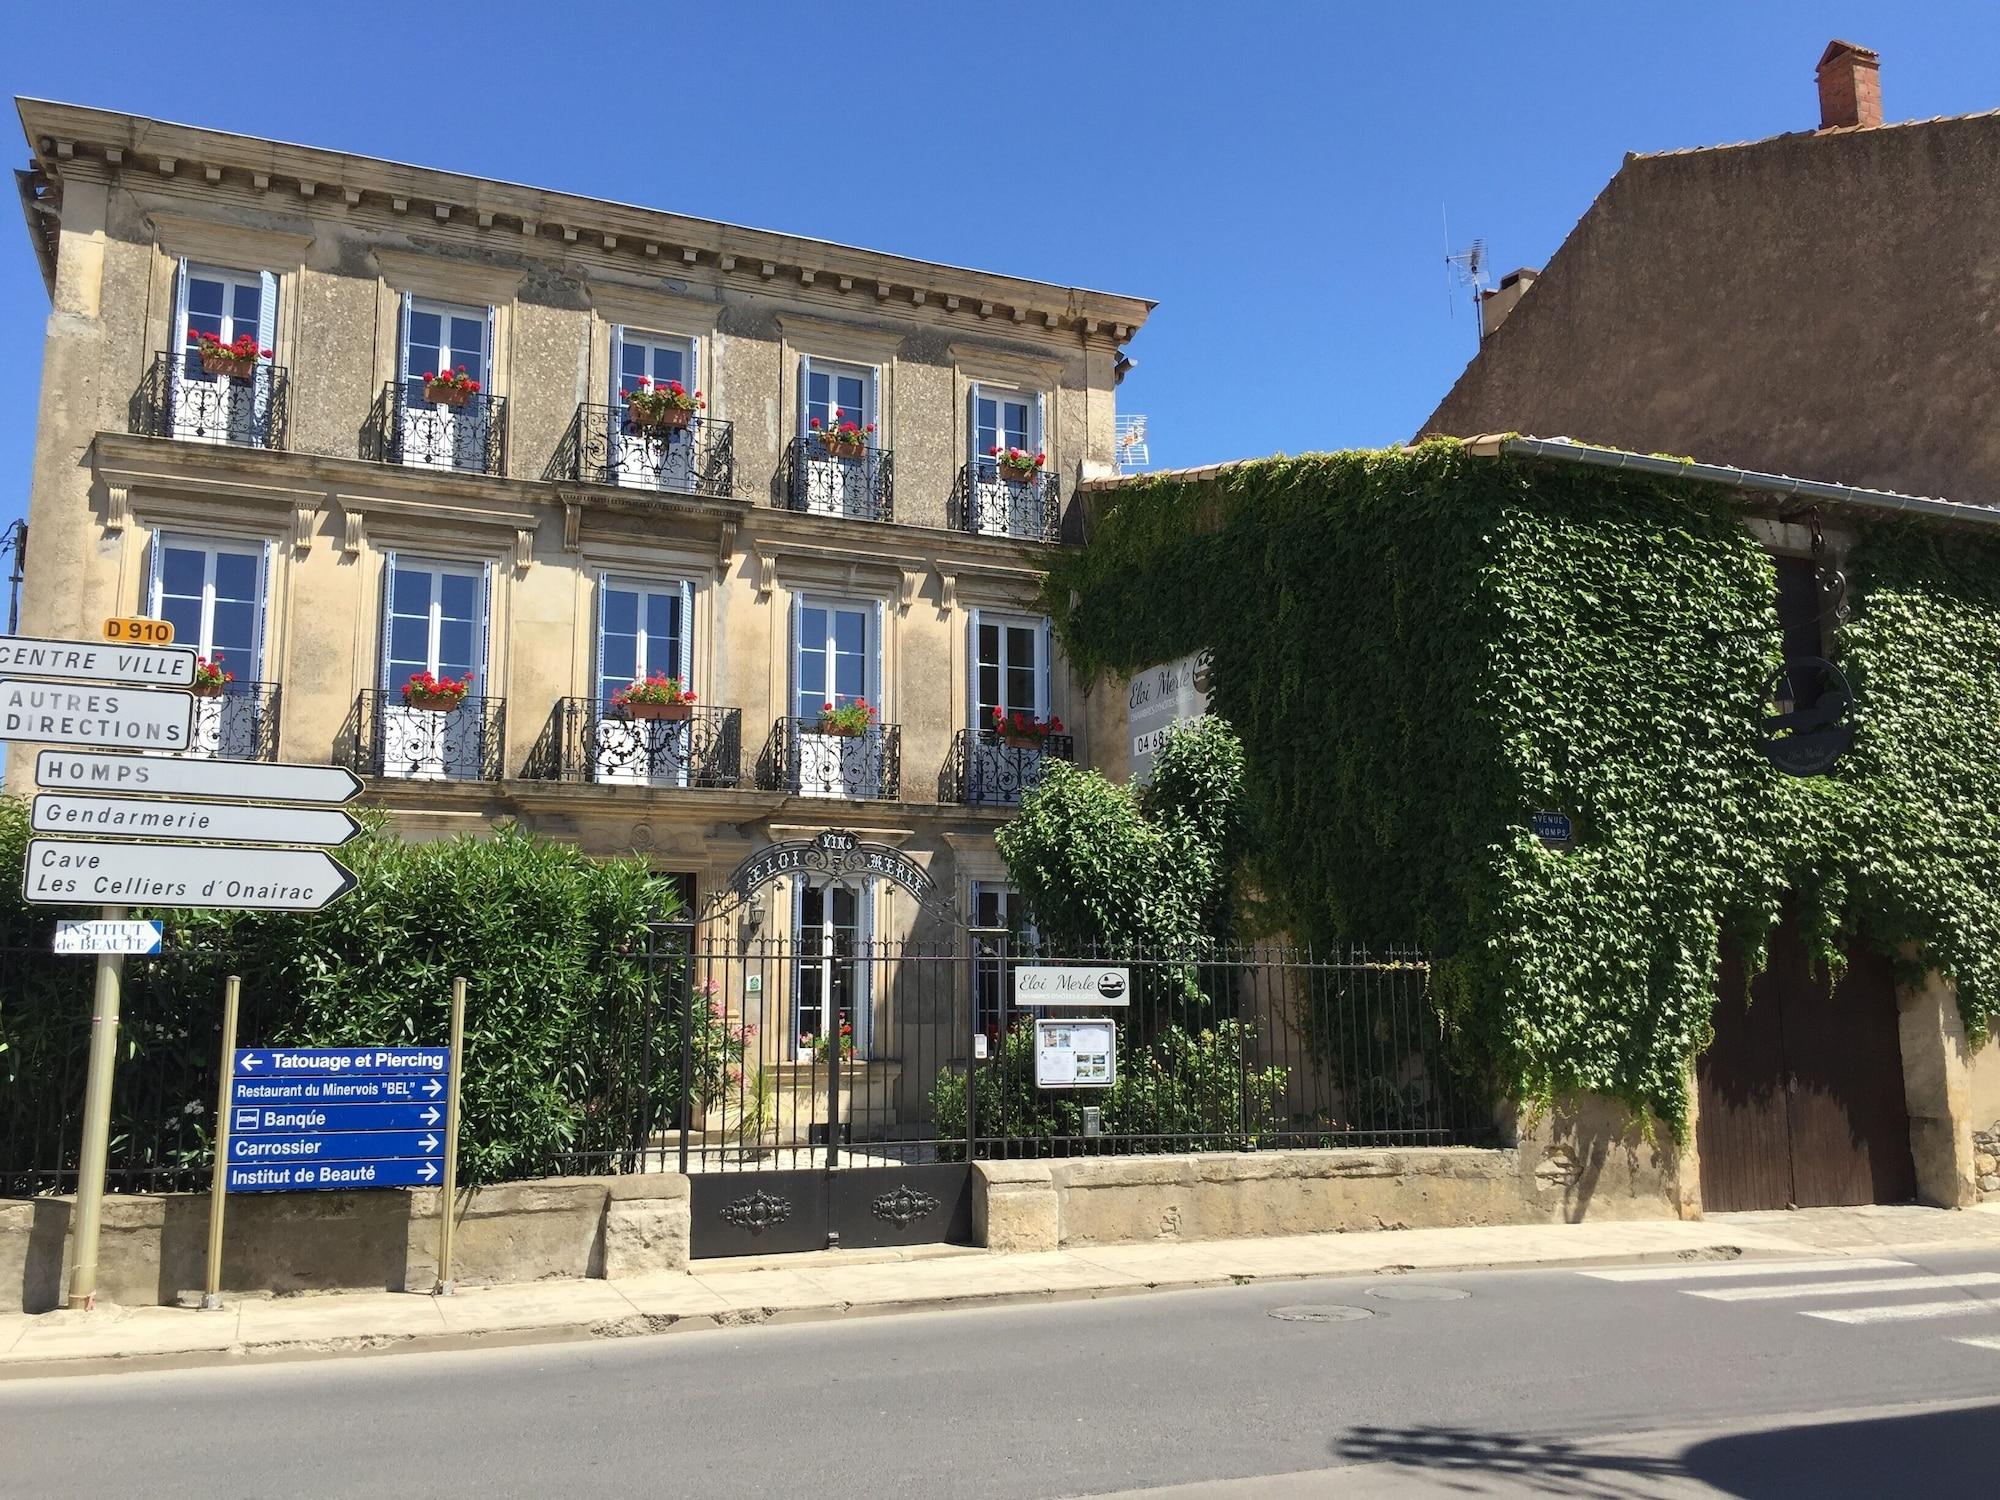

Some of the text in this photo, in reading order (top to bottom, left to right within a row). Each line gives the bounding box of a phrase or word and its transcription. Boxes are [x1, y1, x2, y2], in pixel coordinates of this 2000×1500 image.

[107, 622, 169, 641] D 910
[0, 646, 185, 676] CENTRE VILLE
[9, 690, 120, 714] AUTRES
[1129, 681, 1151, 709] Eloi
[6, 713, 181, 741] DIRECTIONS
[1138, 736, 1149, 753] 04
[47, 761, 150, 784] HOMPS
[45, 804, 211, 829] Gendarmerie
[823, 834, 852, 850] VINS
[41, 850, 101, 869] Cave
[867, 853, 927, 896] MERLE
[37, 874, 314, 900] Les Celliers d'Onairac
[64, 924, 144, 936] INSTITUT
[57, 939, 74, 950] de
[1019, 973, 1095, 991] Eloi Merle
[272, 1052, 444, 1071] Tatouage et Piercing
[237, 1084, 302, 1098] Restaurant
[305, 1083, 320, 1097] du
[323, 1082, 379, 1096] Minervois
[264, 1112, 326, 1129] Banque
[235, 1140, 321, 1156] Carrossier
[232, 1165, 375, 1185] Institut de Beauté
